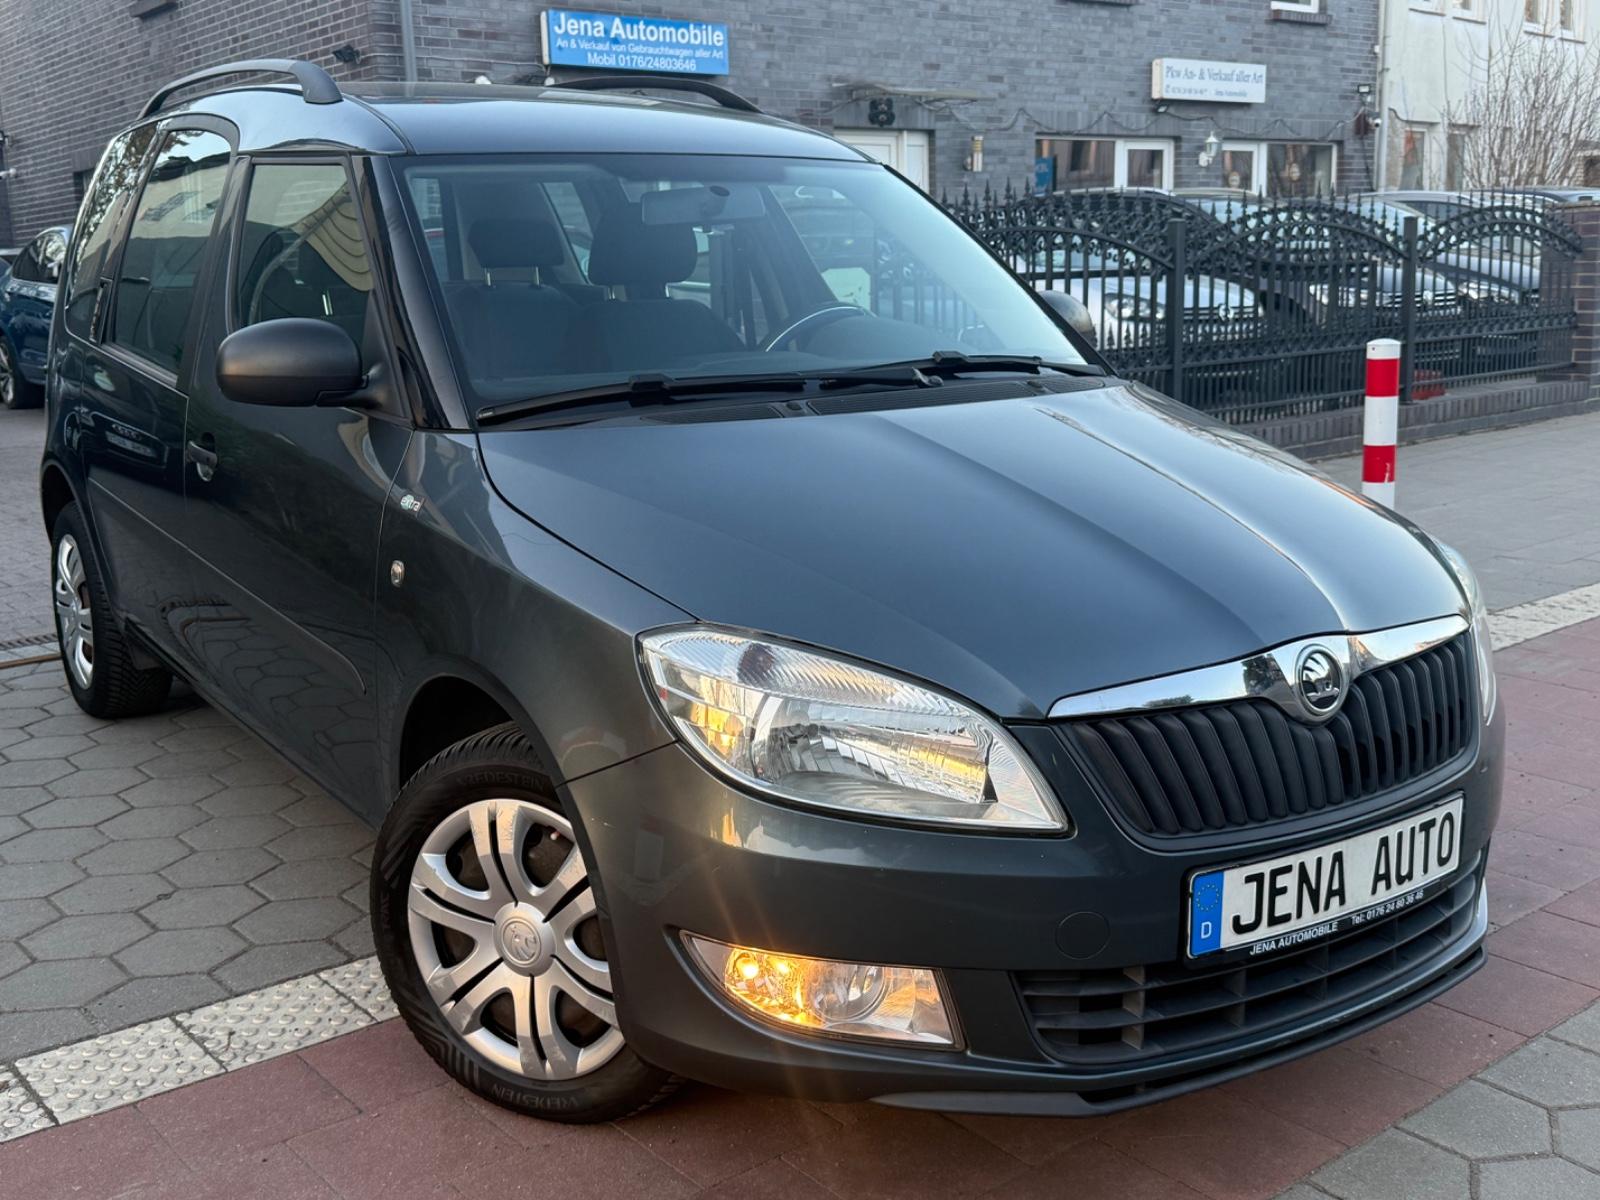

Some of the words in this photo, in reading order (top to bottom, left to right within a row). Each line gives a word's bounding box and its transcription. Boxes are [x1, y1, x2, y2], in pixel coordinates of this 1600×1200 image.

[554, 12, 605, 37] Jena
[610, 17, 725, 47] Automobile
[556, 38, 569, 48] An
[570, 39, 577, 49] &
[578, 40, 610, 51] Verkauf
[611, 43, 626, 52] von
[628, 43, 695, 58] Gebrauchtwagen
[695, 48, 711, 59] aller
[711, 50, 724, 60] Art
[587, 53, 617, 66] Mobil
[618, 55, 697, 72] 0176/24803646
[1166, 65, 1182, 79] Pkw
[1207, 67, 1236, 82] Verkauf
[1236, 69, 1251, 82] aller
[1251, 71, 1264, 84] Art
[1231, 849, 1347, 936] JENA
[1370, 811, 1455, 897] AUTO
[1351, 913, 1365, 926] Tel:
[1366, 905, 1385, 921] 0176
[1386, 902, 1395, 914] 24
[1395, 898, 1405, 910] 80
[1405, 894, 1415, 906] 36
[1415, 889, 1424, 901] 46
[1200, 921, 1212, 940] D
[1250, 940, 1276, 957] JENA
[1277, 921, 1339, 950] AUTOMOBILE
